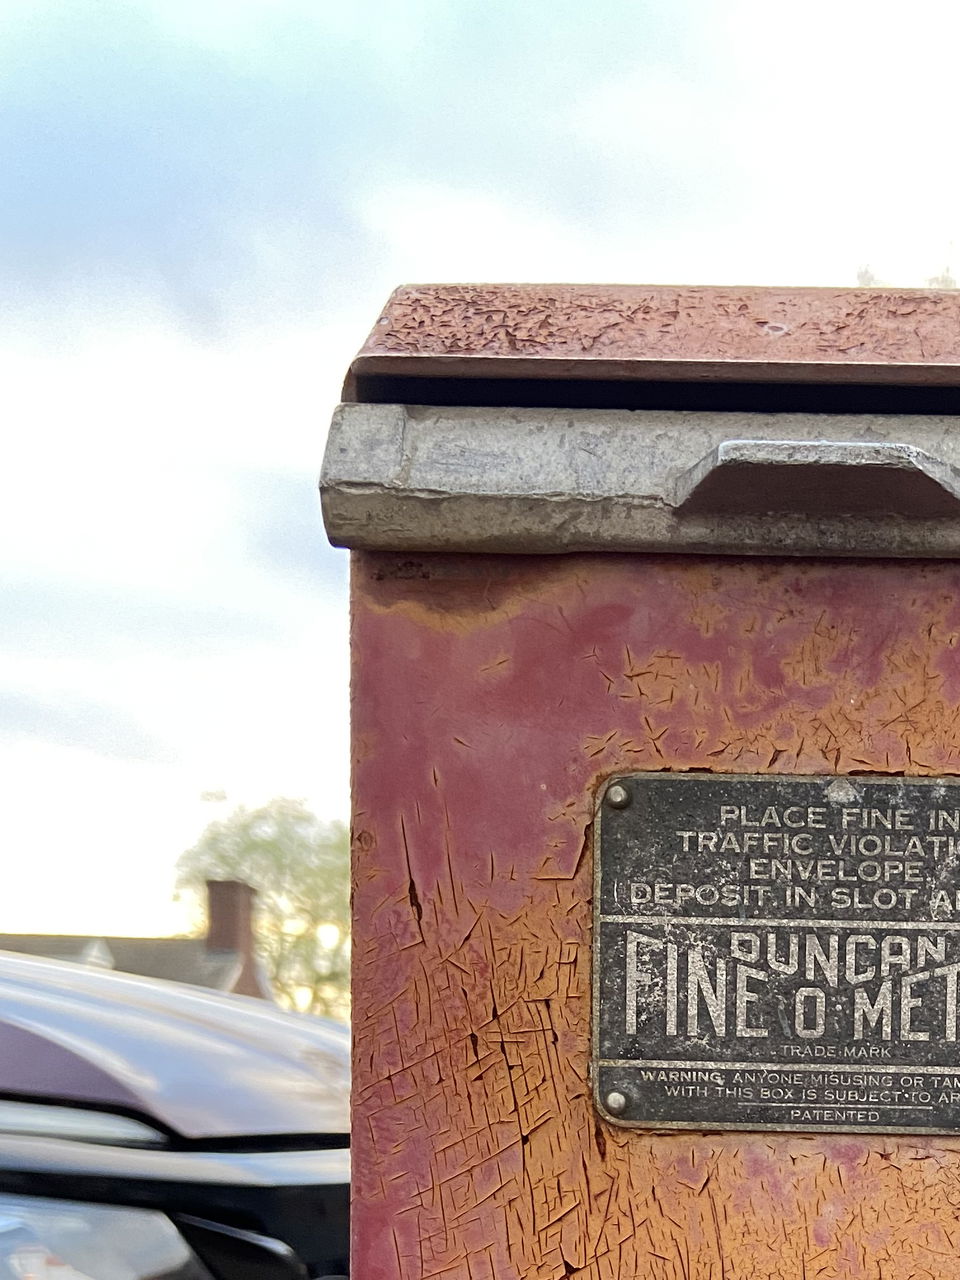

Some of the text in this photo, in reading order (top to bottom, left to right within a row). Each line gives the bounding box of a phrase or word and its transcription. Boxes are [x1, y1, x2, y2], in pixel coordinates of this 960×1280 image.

[720, 805, 960, 832] PLACE FINE IN
[675, 830, 814, 855] TRAFFIC
[749, 858, 925, 882] ENVELOPE
[629, 882, 772, 906] DEPOSIT
[785, 885, 817, 908] IN
[830, 887, 919, 911] SLOT
[730, 931, 946, 989] DUNCAN
[625, 930, 769, 1038] FINE
[794, 987, 826, 1039] O
[780, 1044, 893, 1059] TRADE MARK
[732, 1071, 804, 1086] ANYONE
[810, 1072, 894, 1088] MISUSING
[899, 1075, 925, 1088] OR
[664, 1085, 708, 1098] WITH
[714, 1086, 754, 1099] THIS
[760, 1087, 794, 1100] BOX
[801, 1088, 818, 1101] IS
[824, 1089, 903, 1103] SUBJECT
[910, 1091, 932, 1103] TO
[789, 1109, 881, 1123] PATENTED
